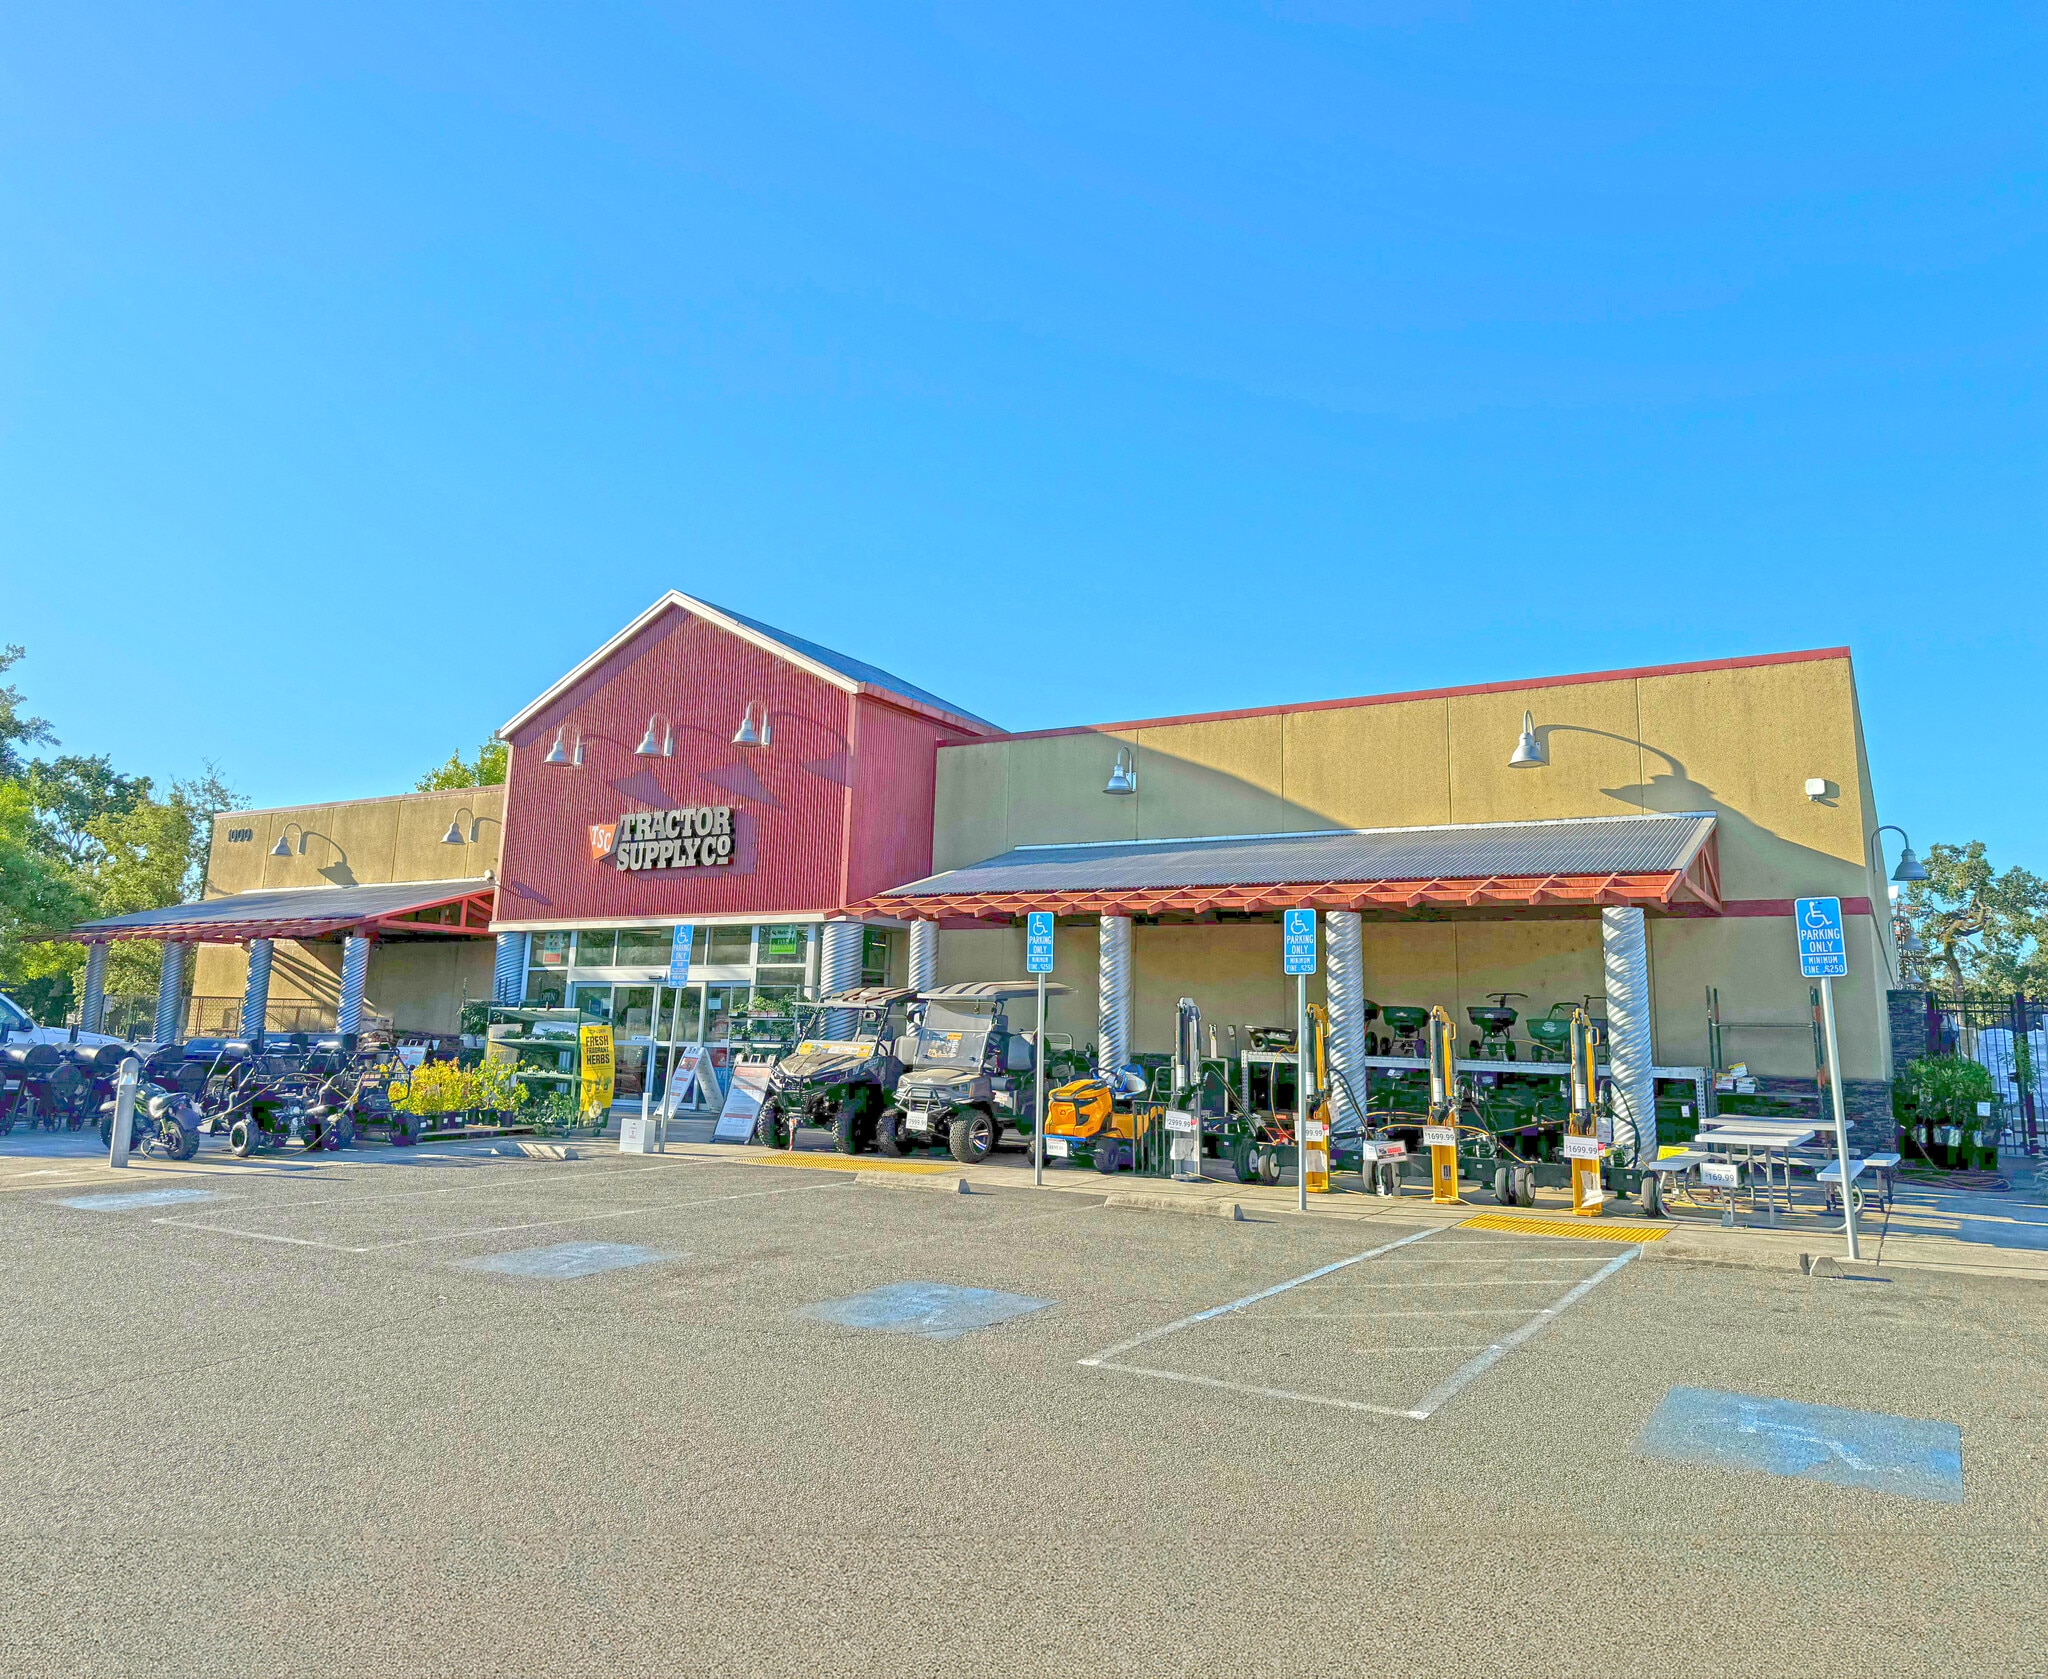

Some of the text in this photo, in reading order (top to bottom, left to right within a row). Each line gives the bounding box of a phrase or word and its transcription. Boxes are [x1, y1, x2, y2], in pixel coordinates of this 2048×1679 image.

[620, 806, 731, 842] TRACTOR
[591, 826, 612, 853] TSC
[1287, 934, 1314, 944] PARKING
[1801, 928, 1840, 941] PARKING
[1029, 935, 1052, 945] PARKING
[1033, 945, 1047, 954] ONLY
[1291, 944, 1308, 955] ONLY
[1809, 941, 1833, 953] ONLY
[1808, 956, 1838, 964] MINIMUM
[1804, 965, 1820, 973] FINE
[541, 992, 556, 1001] OPEN
[585, 1035, 609, 1047] FRESH
[586, 1054, 610, 1065] HERBS
[1167, 1118, 1191, 1128] $2999.99
[1425, 1132, 1455, 1141] $1699.99
[1565, 1144, 1598, 1155] $1699.99
[1705, 1173, 1735, 1182] $169.99
